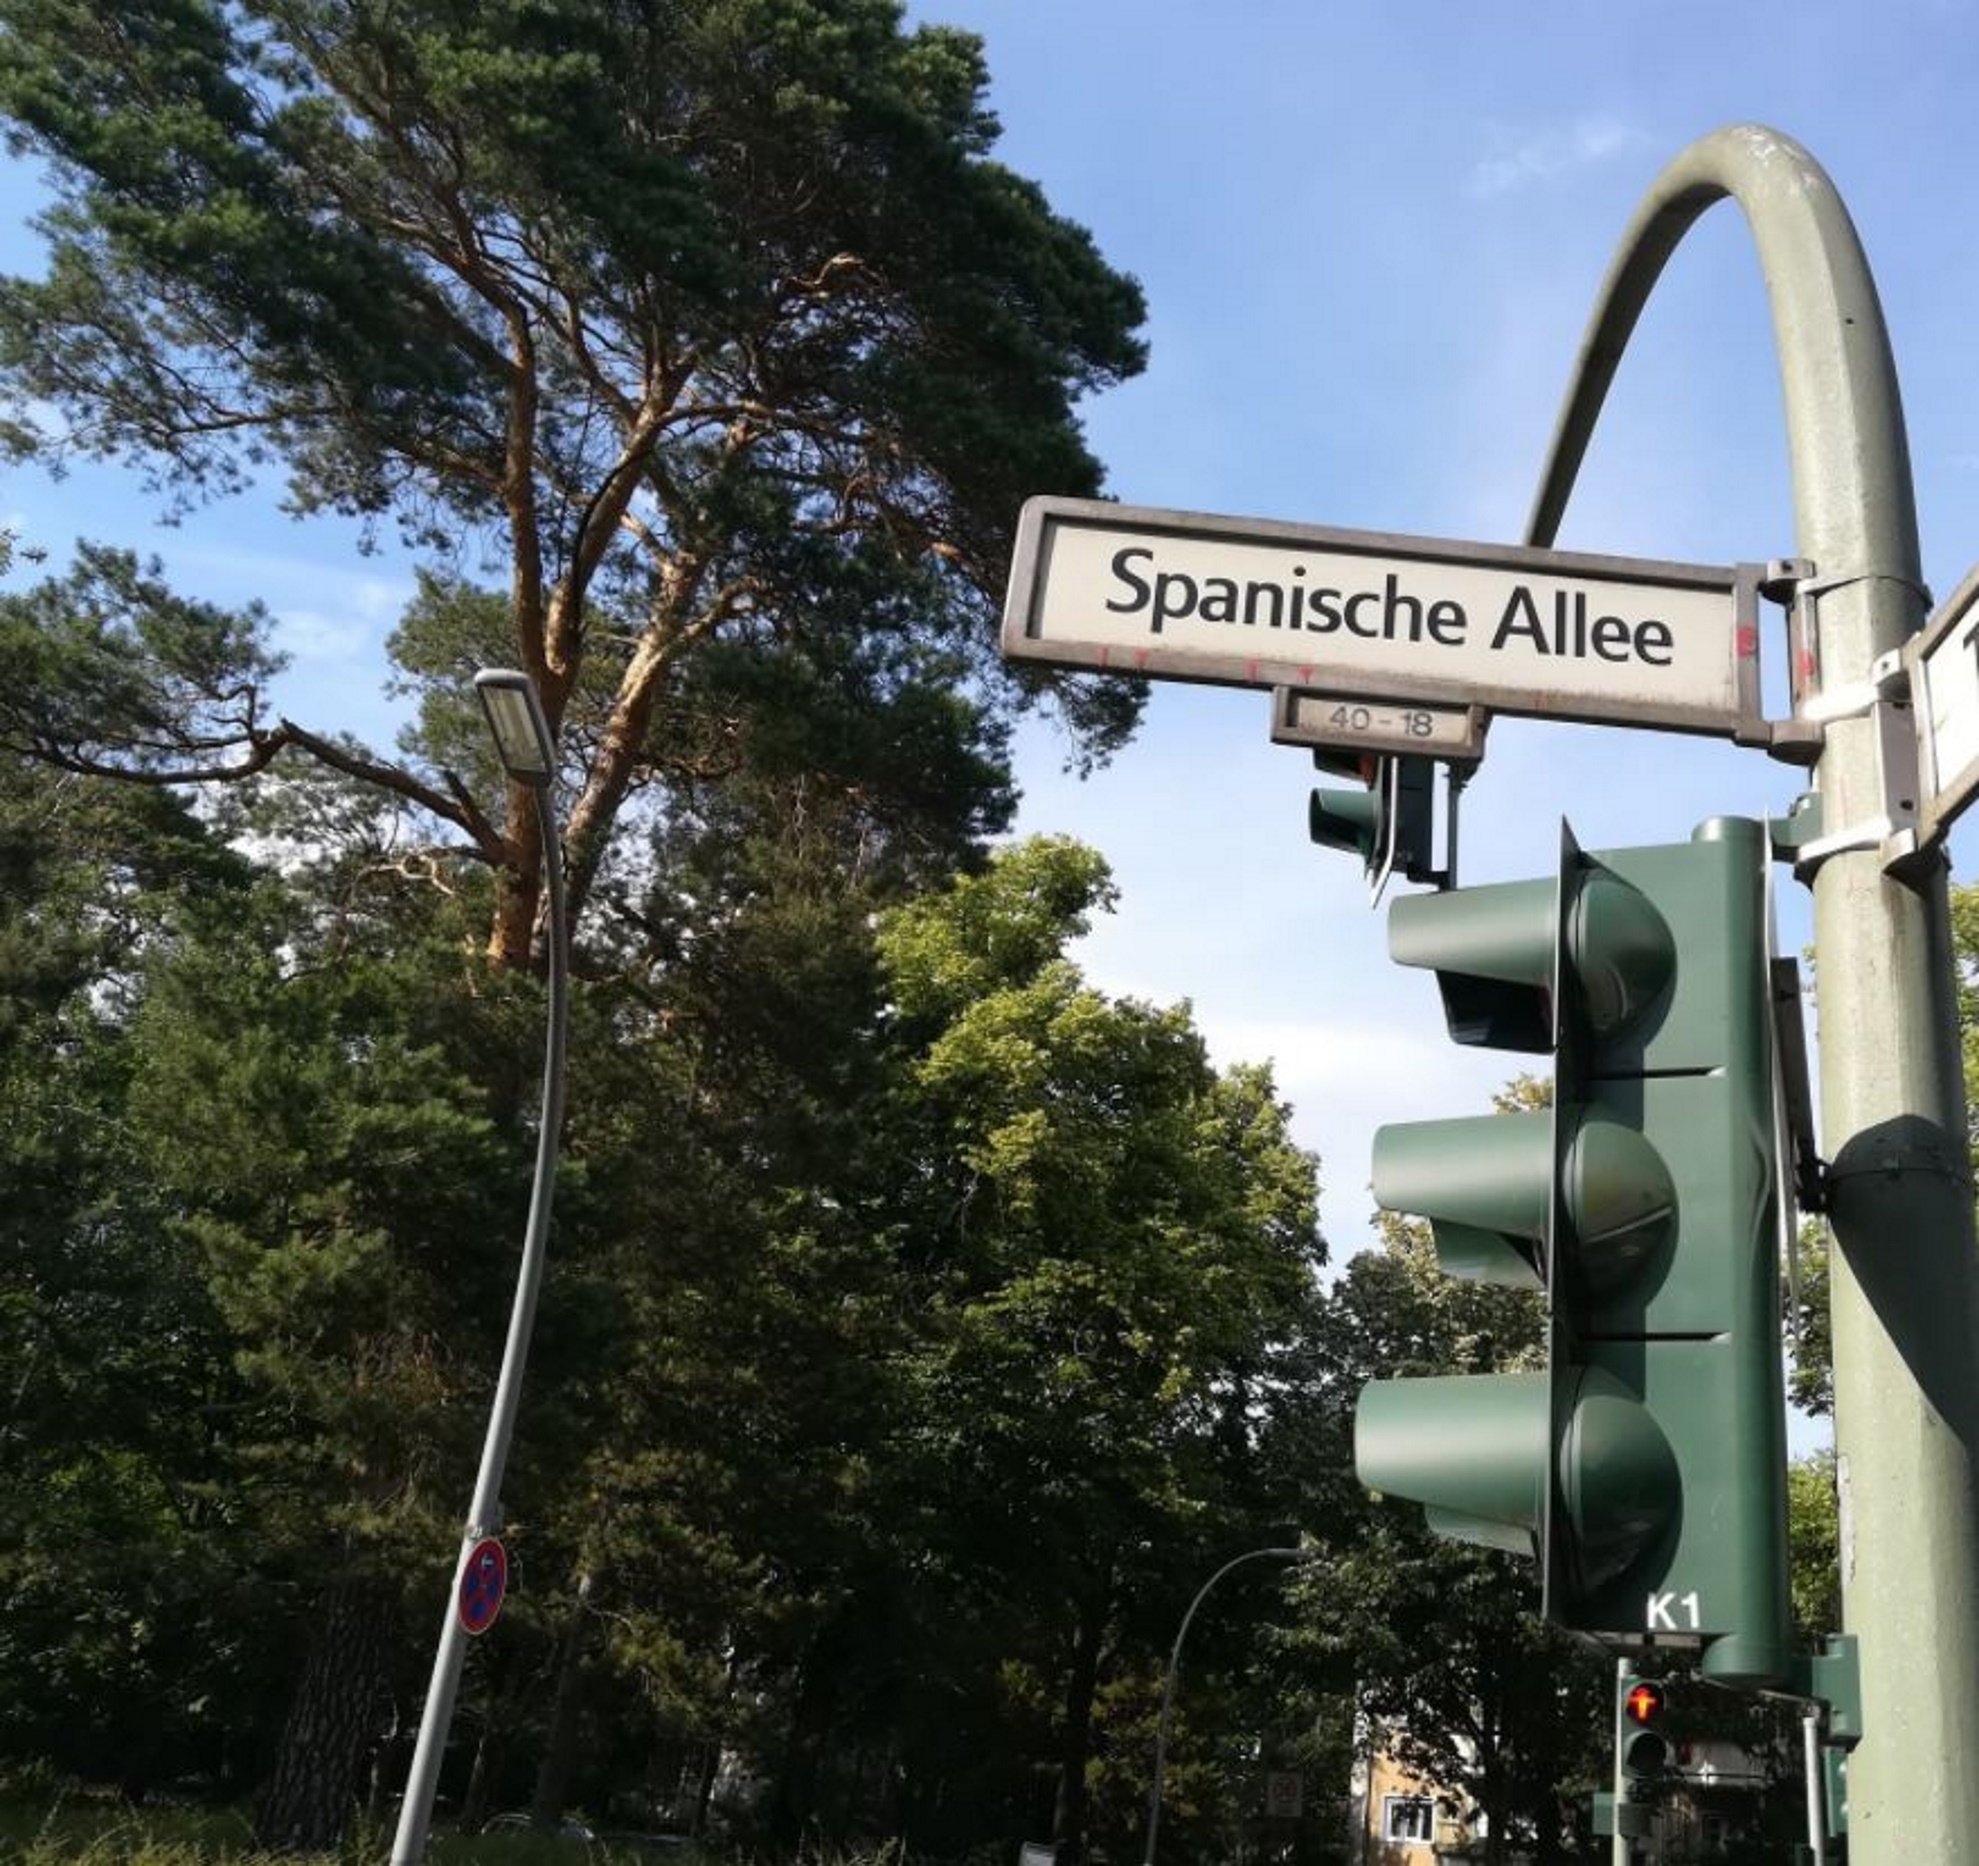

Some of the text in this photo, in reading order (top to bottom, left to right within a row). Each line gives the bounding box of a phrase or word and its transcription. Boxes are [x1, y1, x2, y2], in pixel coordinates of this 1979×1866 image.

[1105, 547, 1674, 666] Spanische Allee
[1329, 706, 1370, 730] 40
[1402, 711, 1433, 737] 18
[1647, 1591, 1700, 1630] K1
